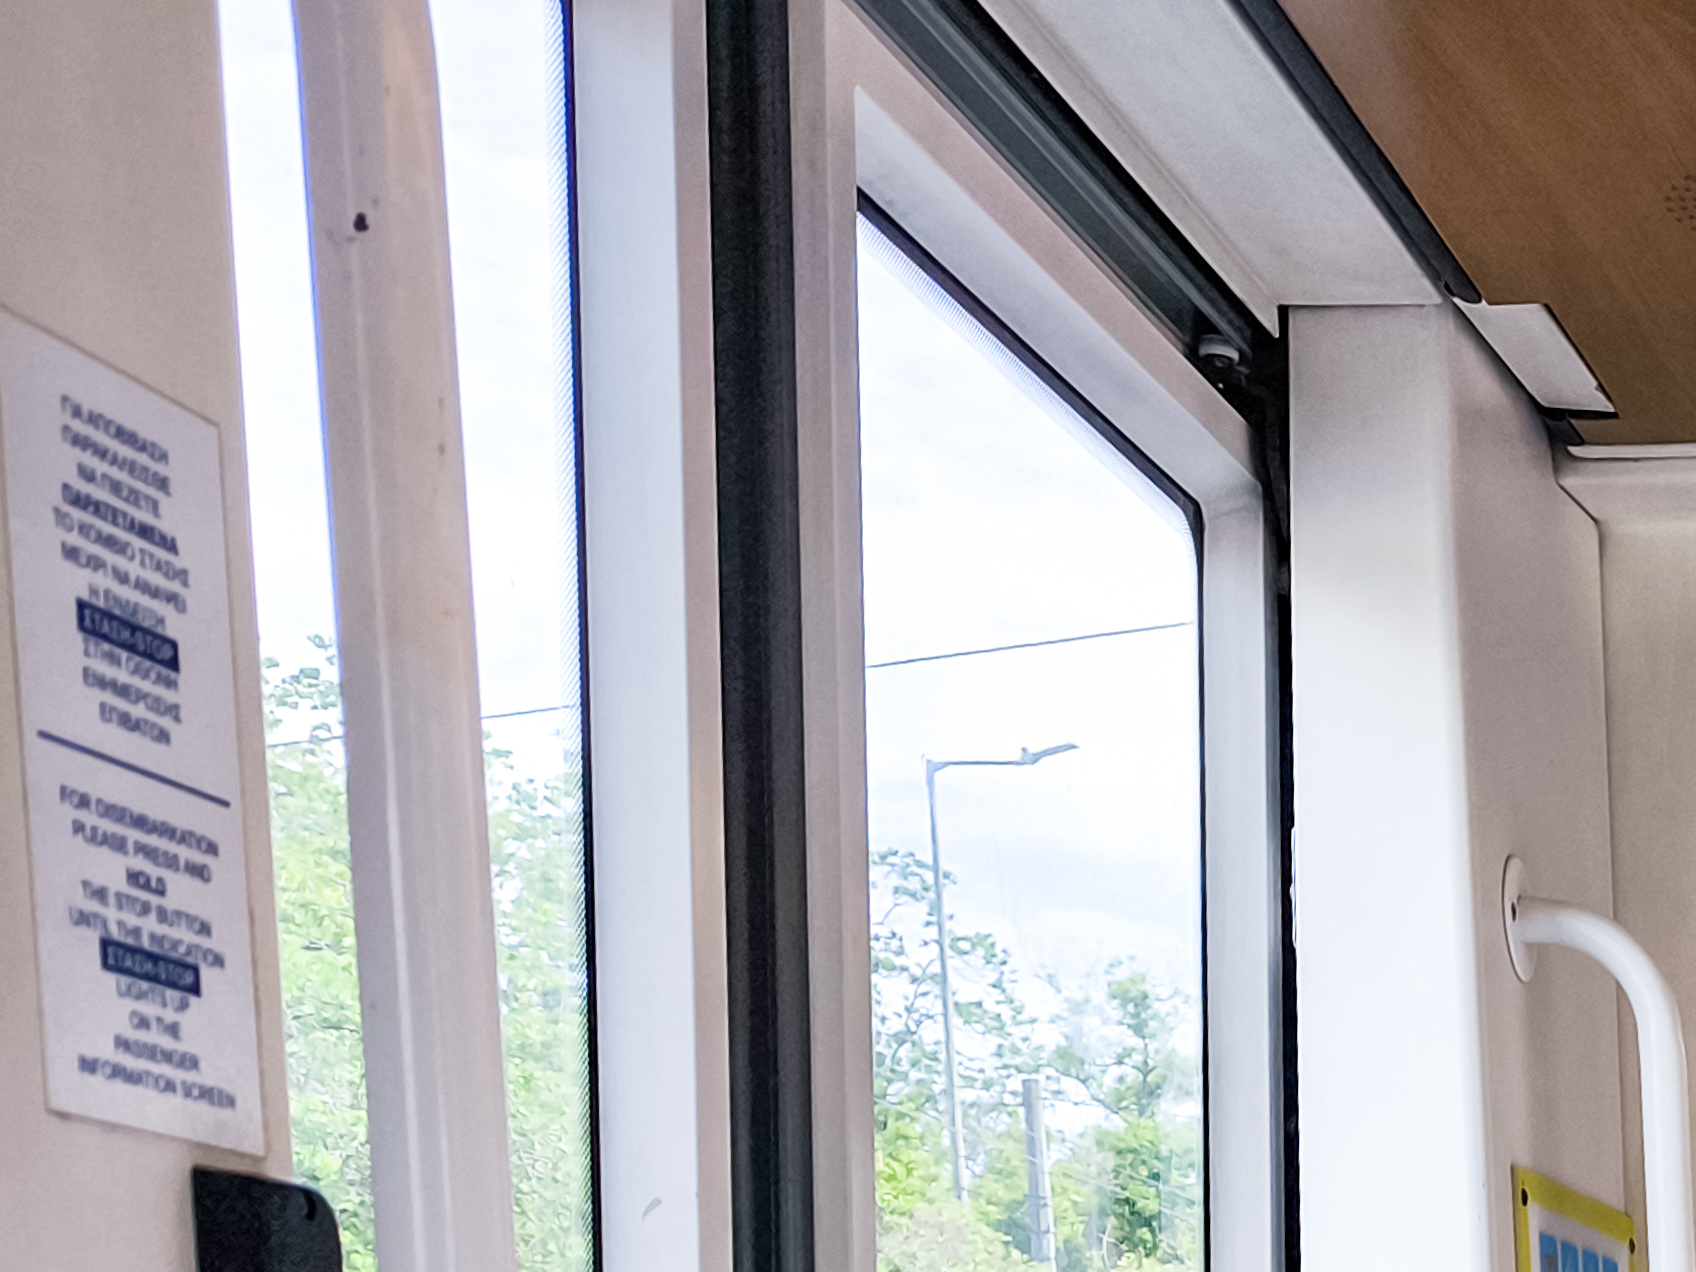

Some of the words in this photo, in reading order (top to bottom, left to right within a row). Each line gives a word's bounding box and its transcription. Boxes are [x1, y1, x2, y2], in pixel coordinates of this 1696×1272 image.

[59, 784, 92, 811] FOR
[71, 819, 129, 855] PLEASE
[132, 840, 180, 873] PRESS
[182, 859, 211, 884] AND
[125, 869, 166, 897] HOLD
[81, 879, 110, 907] THE
[114, 891, 152, 918] STOP
[155, 904, 211, 938] BUTTON
[116, 919, 143, 946] THE
[170, 990, 190, 1013] UP
[128, 1009, 151, 1032] ON
[155, 1016, 181, 1041] THE
[113, 1035, 199, 1071] PASSENGER
[77, 1055, 177, 1094] INFORMATION
[180, 1080, 235, 1109] SCREEN
